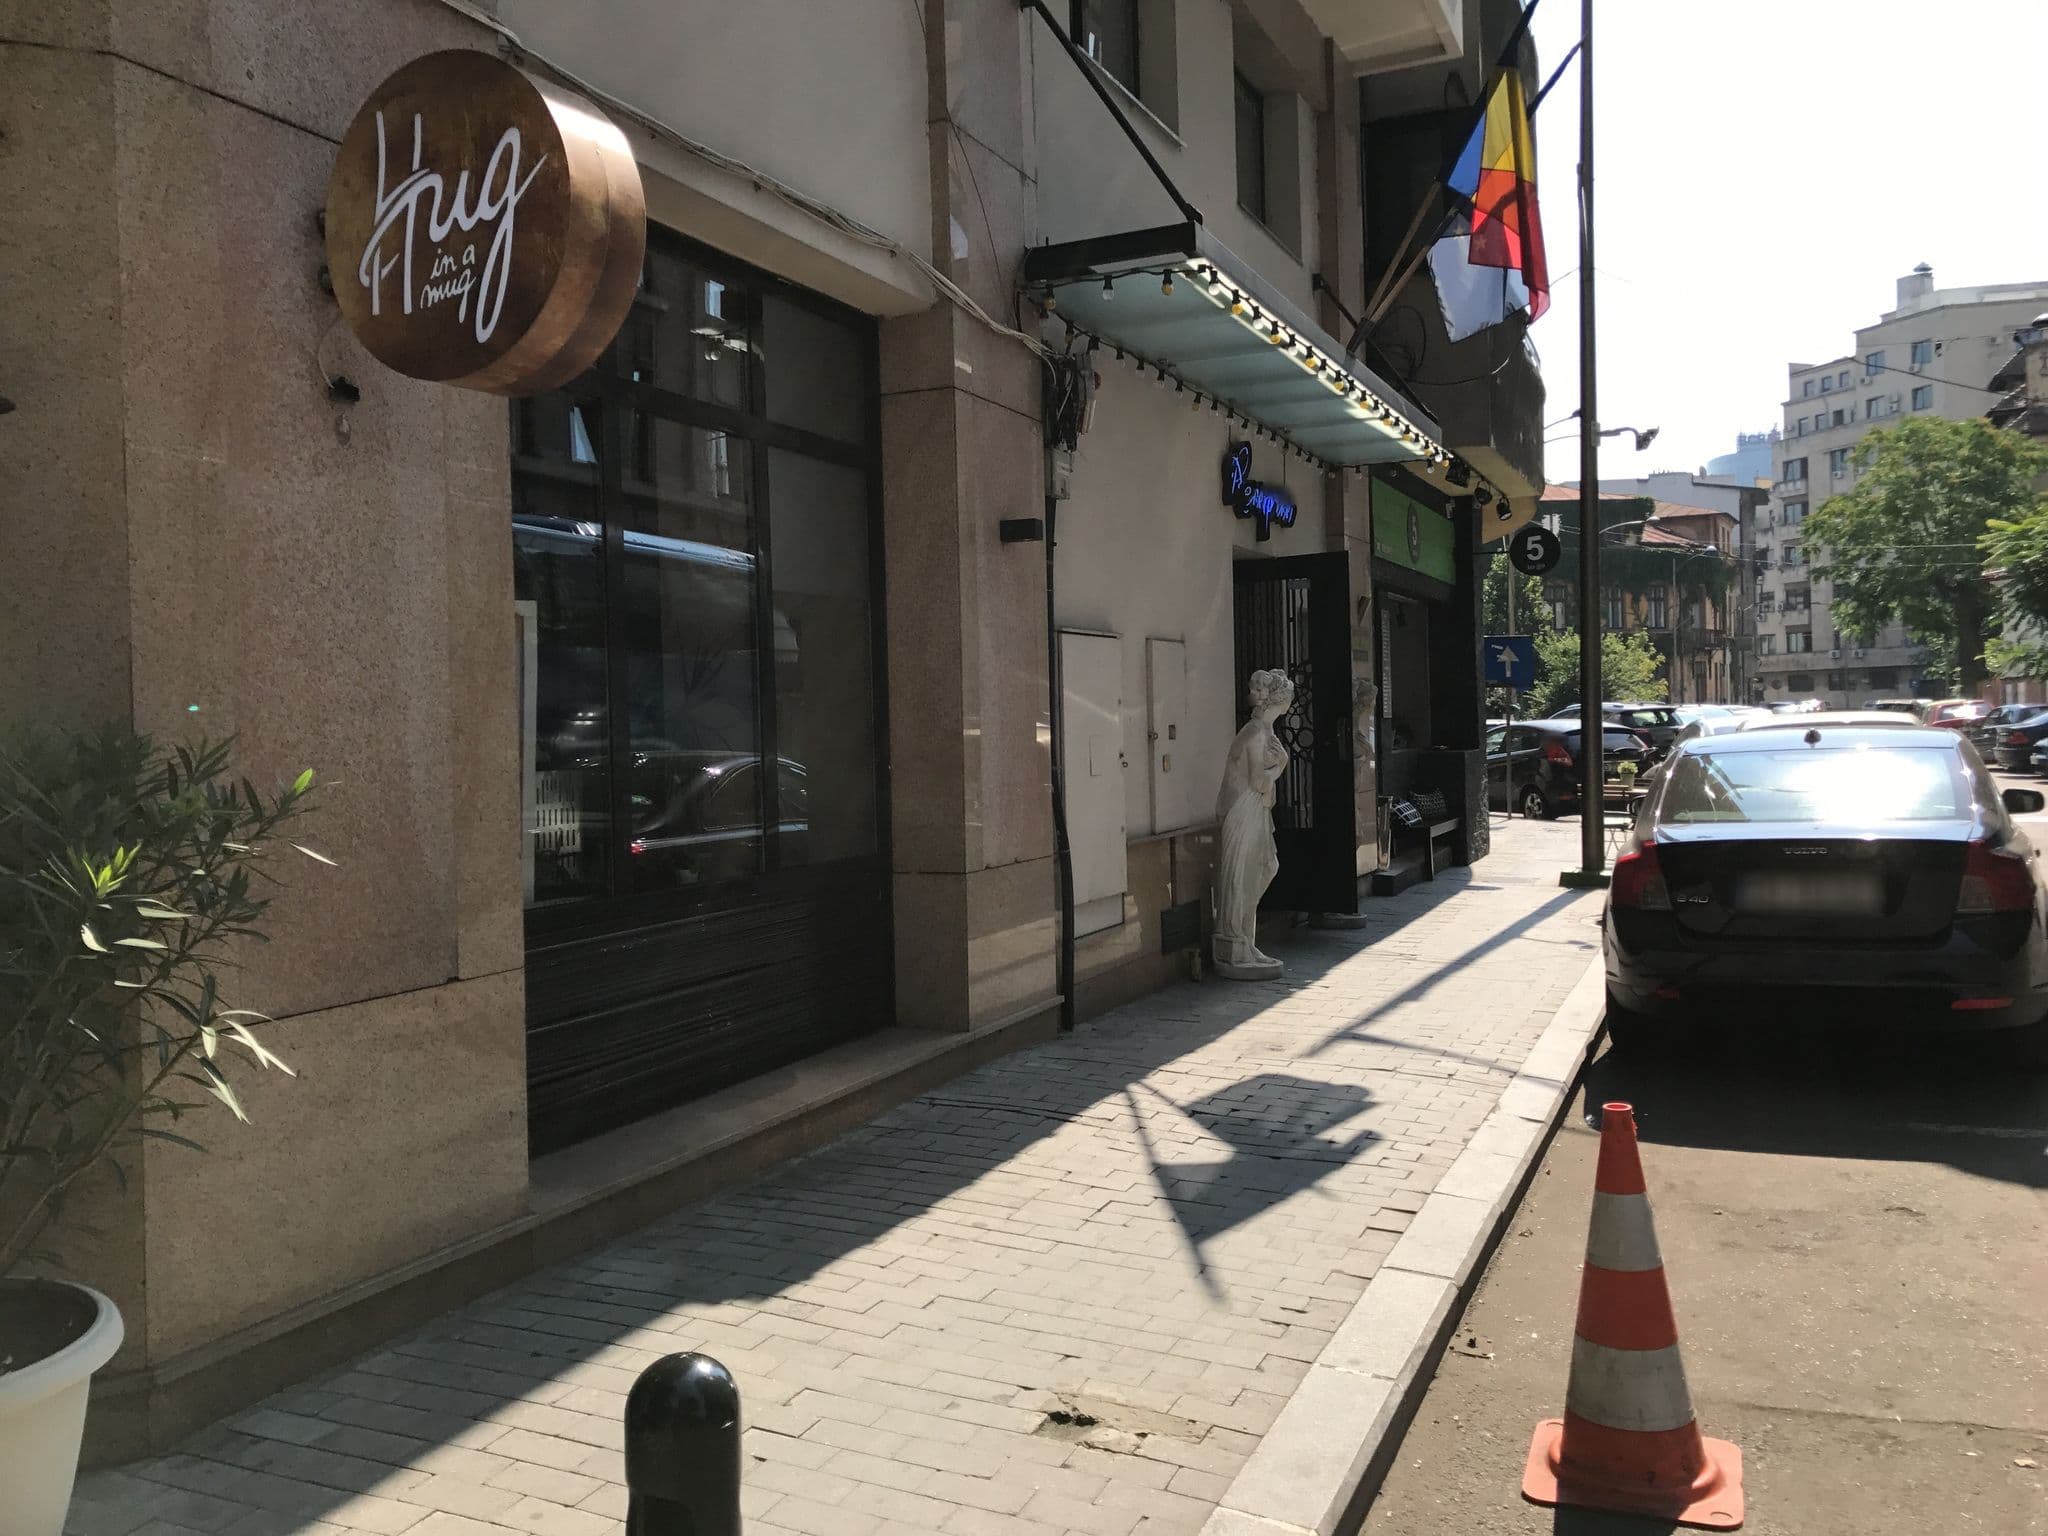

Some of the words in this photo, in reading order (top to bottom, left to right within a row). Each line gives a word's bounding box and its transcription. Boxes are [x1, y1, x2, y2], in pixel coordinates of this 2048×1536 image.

[359, 110, 548, 344] Hug
[430, 247, 458, 280] in
[462, 243, 476, 266] a
[420, 268, 477, 324] mug
[1526, 534, 1545, 561] 5
